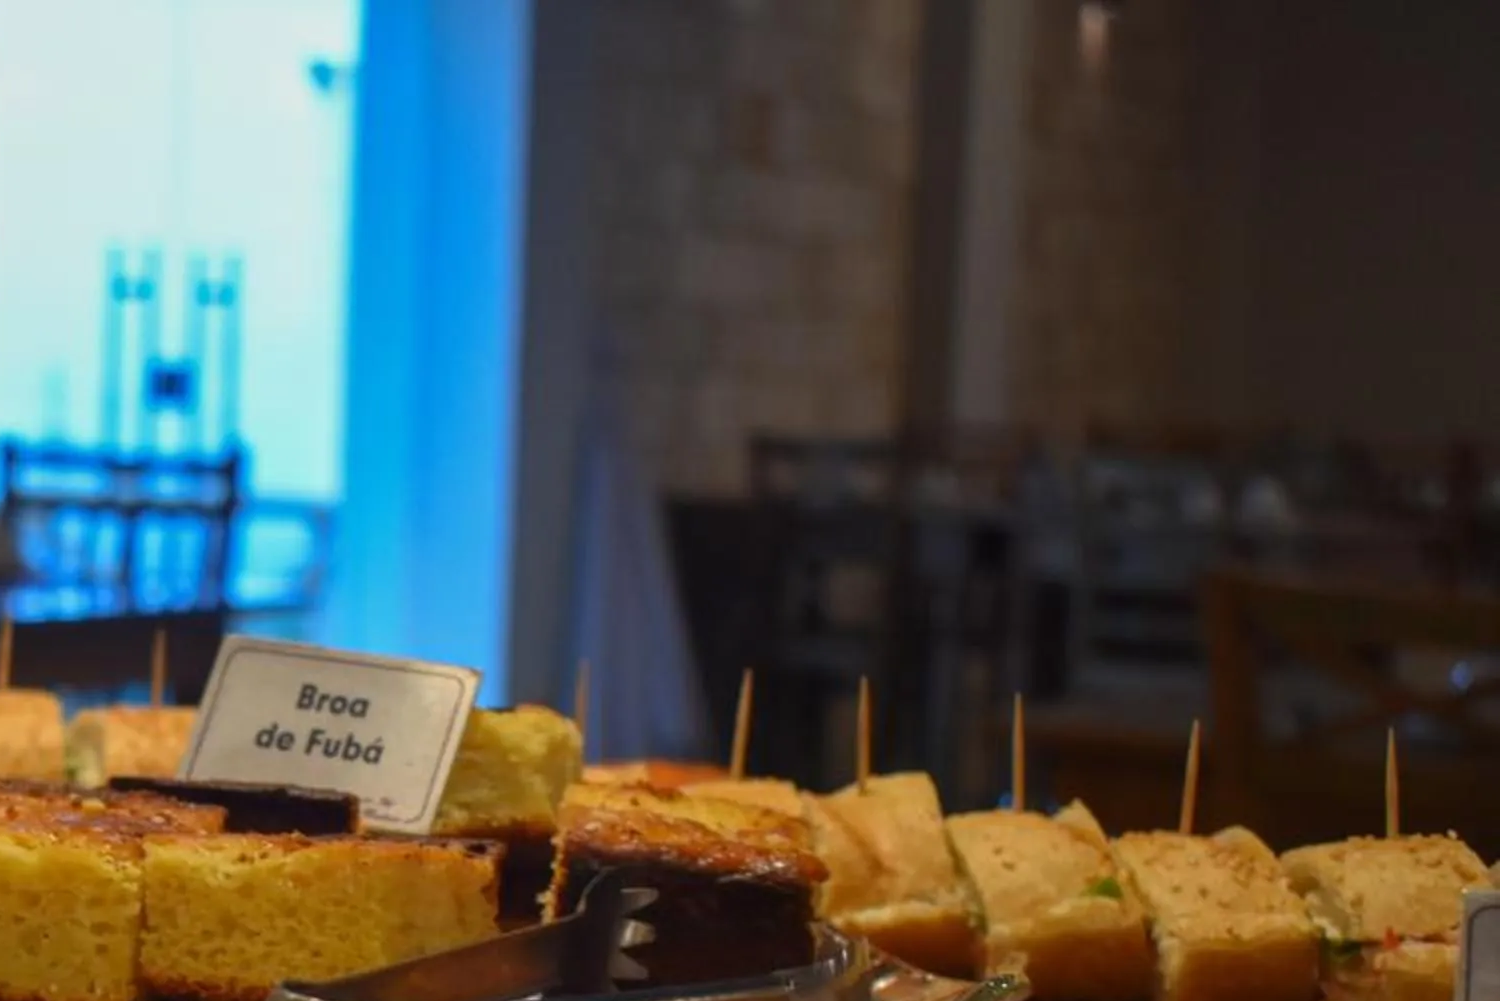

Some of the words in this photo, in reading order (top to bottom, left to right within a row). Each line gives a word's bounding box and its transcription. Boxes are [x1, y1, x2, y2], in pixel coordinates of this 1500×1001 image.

[295, 683, 370, 718] Broa
[255, 722, 295, 751] de
[303, 729, 385, 765] Fubá
